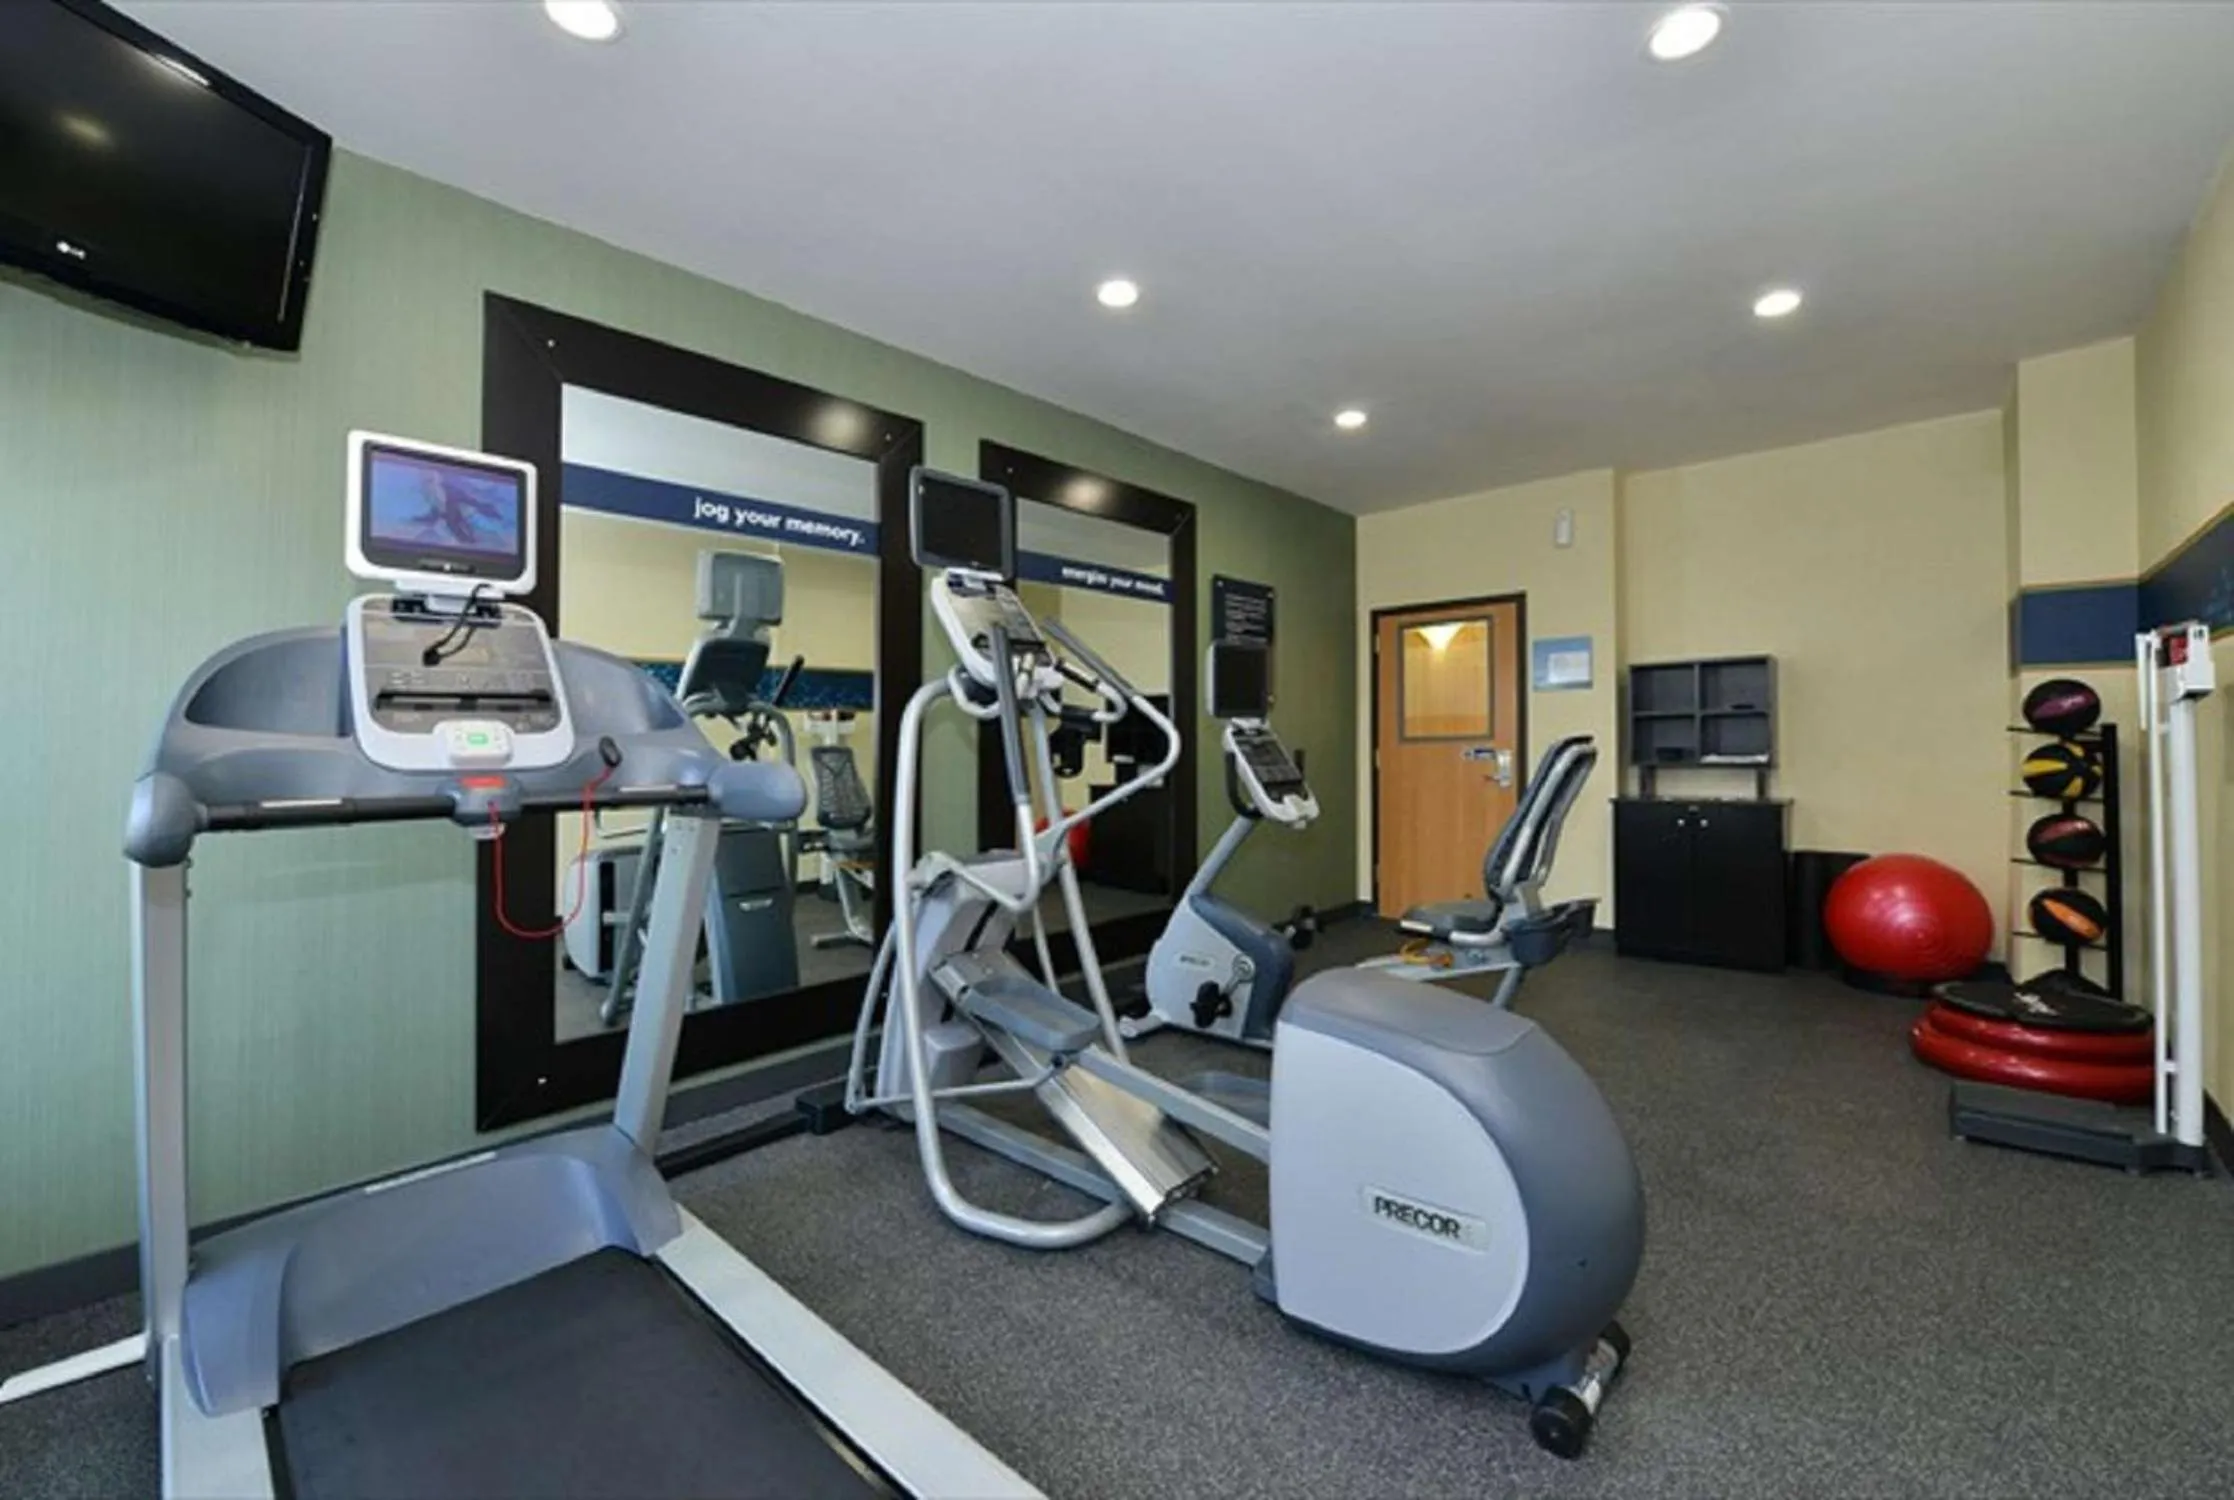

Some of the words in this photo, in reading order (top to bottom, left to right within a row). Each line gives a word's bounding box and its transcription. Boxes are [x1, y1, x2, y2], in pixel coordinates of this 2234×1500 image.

[693, 496, 730, 524] jog
[733, 506, 782, 528] your
[784, 517, 866, 547] memory.
[1374, 1195, 1461, 1240] PRECOR
